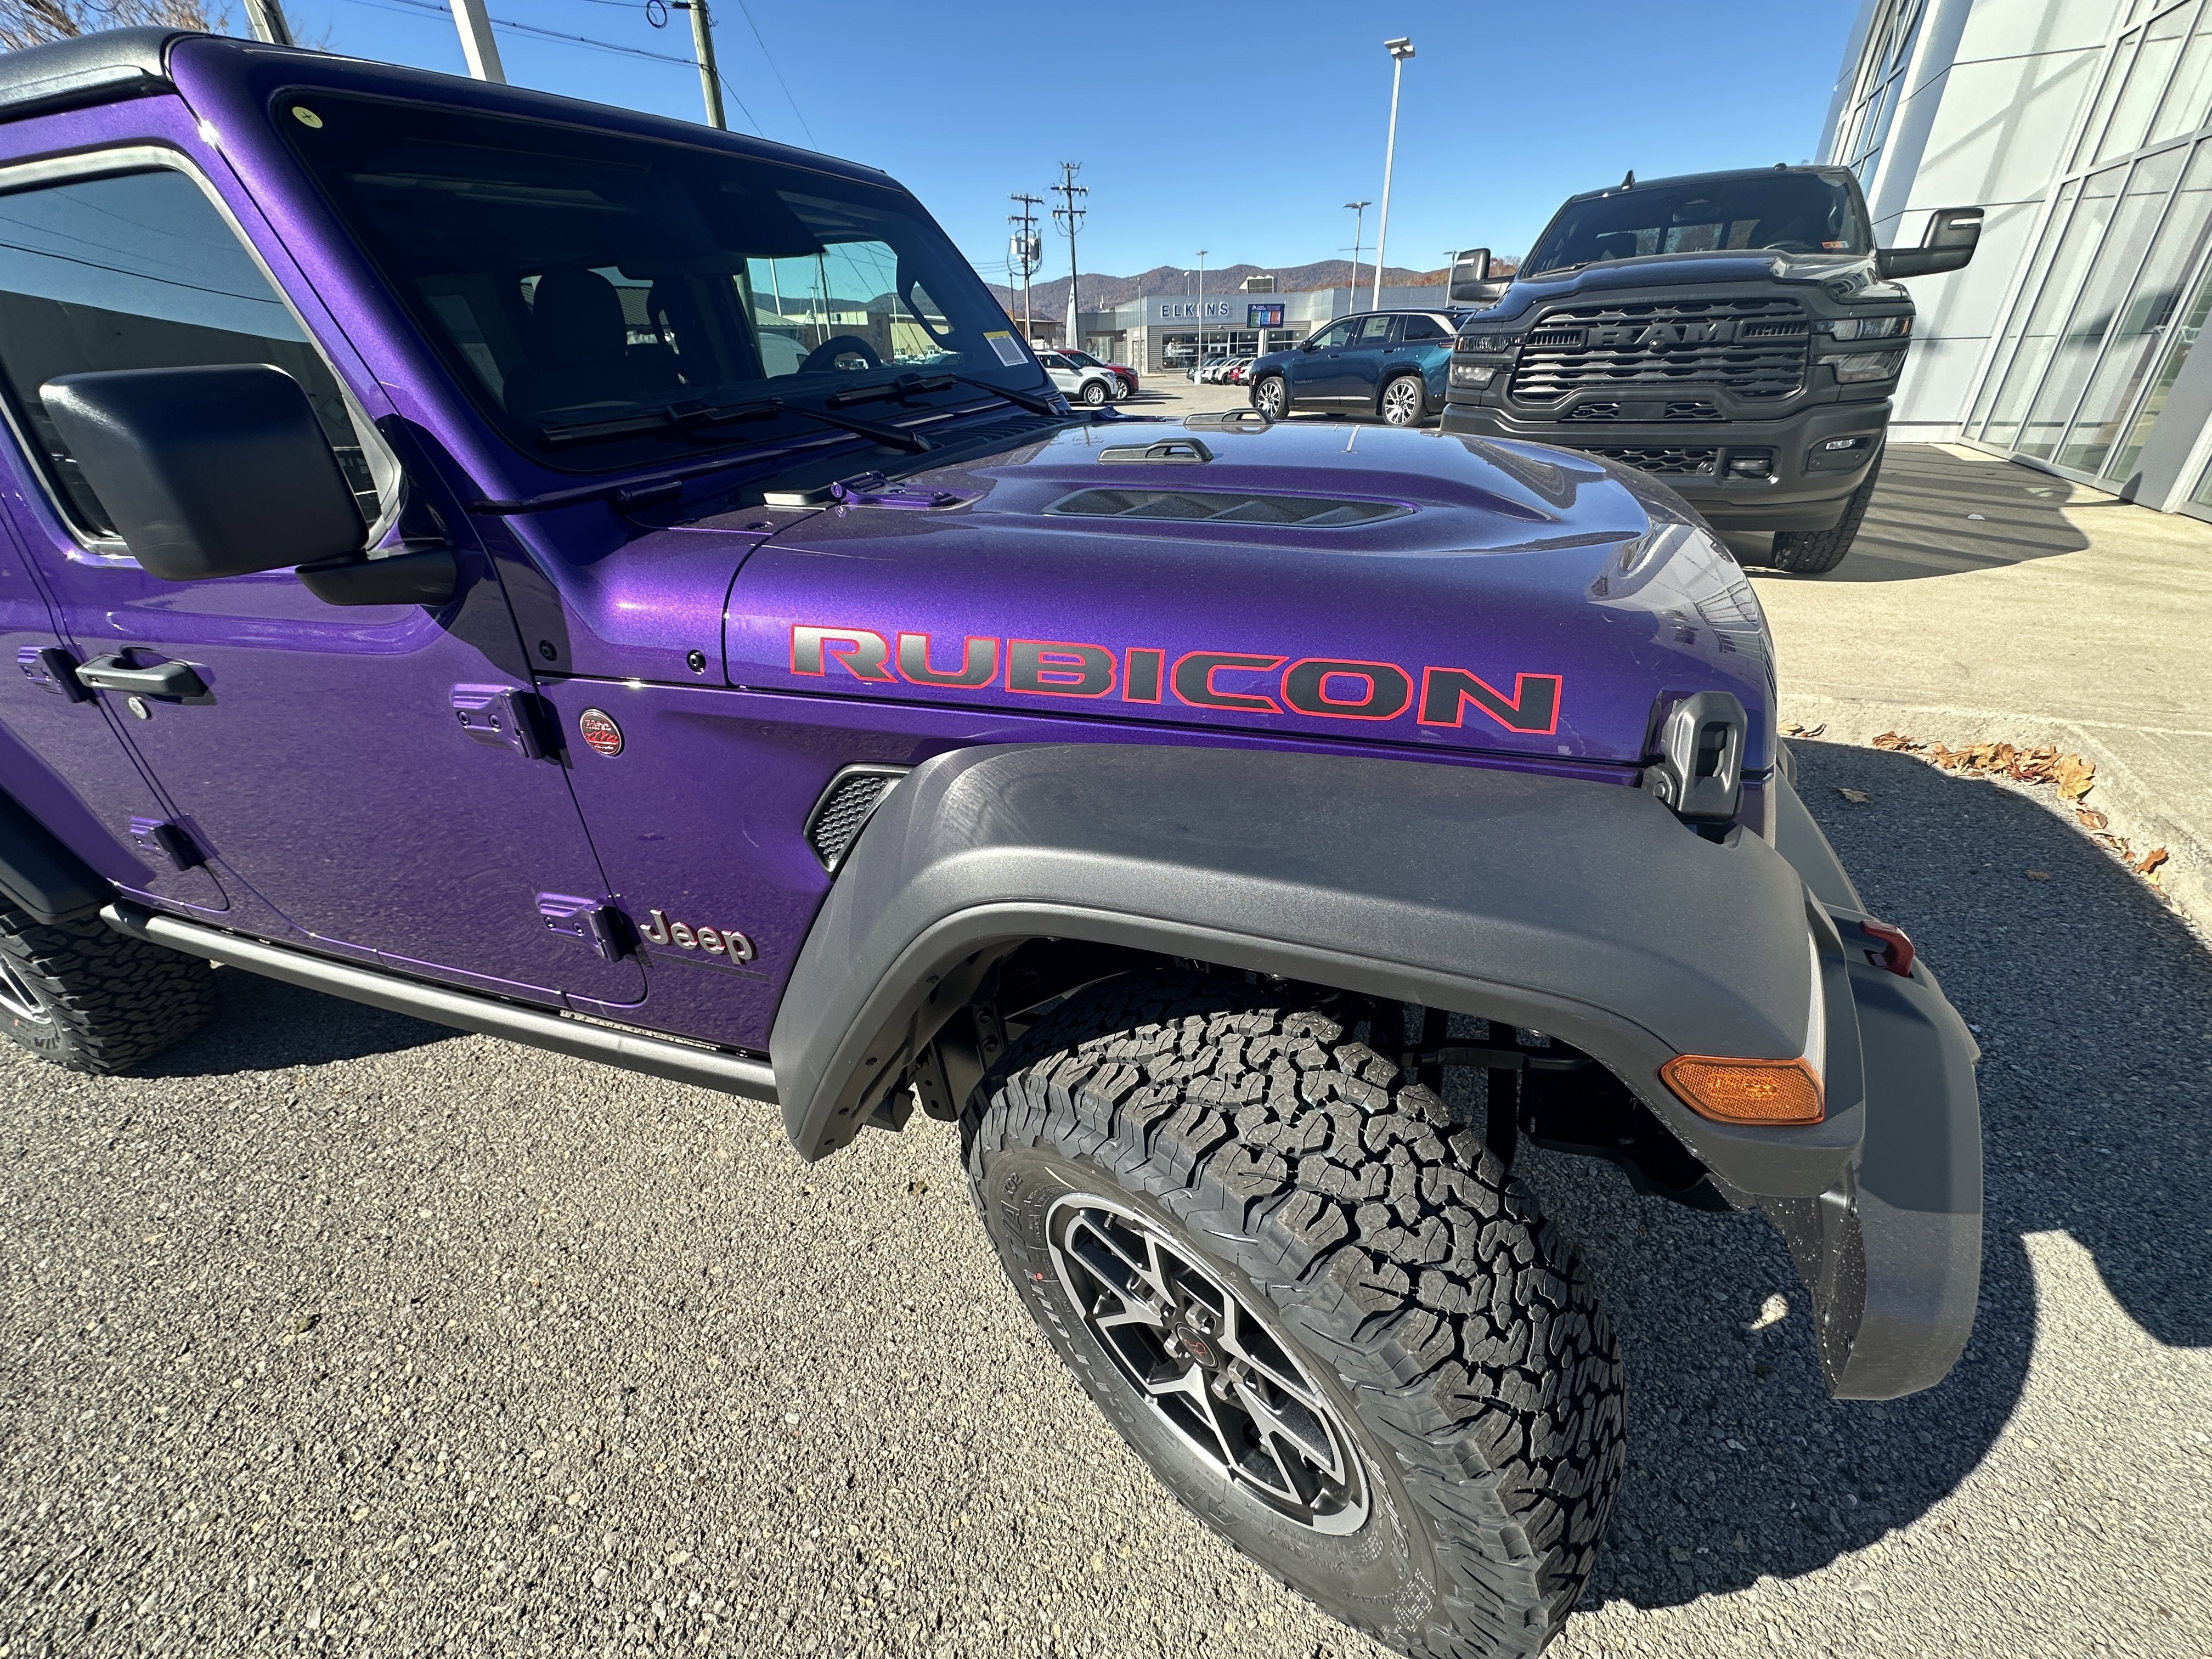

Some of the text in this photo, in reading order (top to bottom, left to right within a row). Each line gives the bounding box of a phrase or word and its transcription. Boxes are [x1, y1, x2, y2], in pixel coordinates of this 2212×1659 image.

[1590, 321, 1735, 346] RAM
[789, 623, 1564, 736] RUBICON
[640, 909, 758, 966] Jeep
